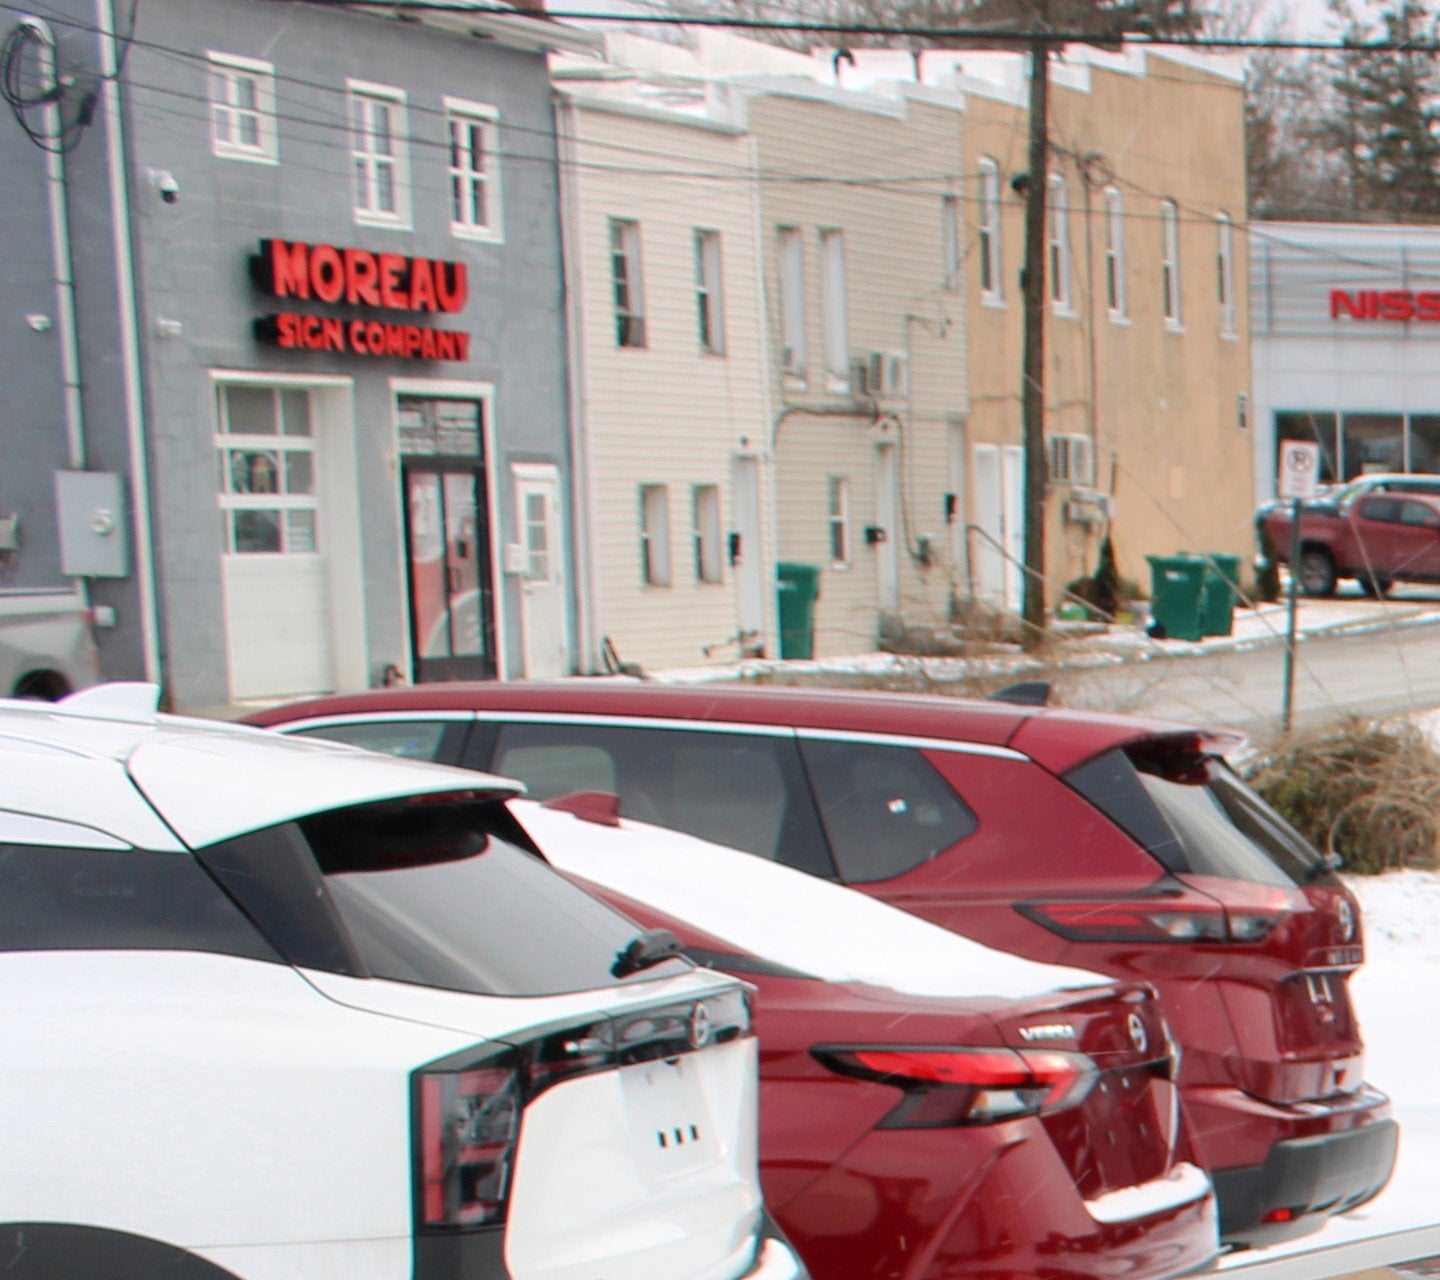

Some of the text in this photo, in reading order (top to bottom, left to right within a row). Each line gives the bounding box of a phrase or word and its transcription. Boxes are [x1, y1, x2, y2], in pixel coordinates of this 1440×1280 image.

[270, 238, 468, 314] MOREAU
[275, 313, 471, 361] SIGN COMPANY
